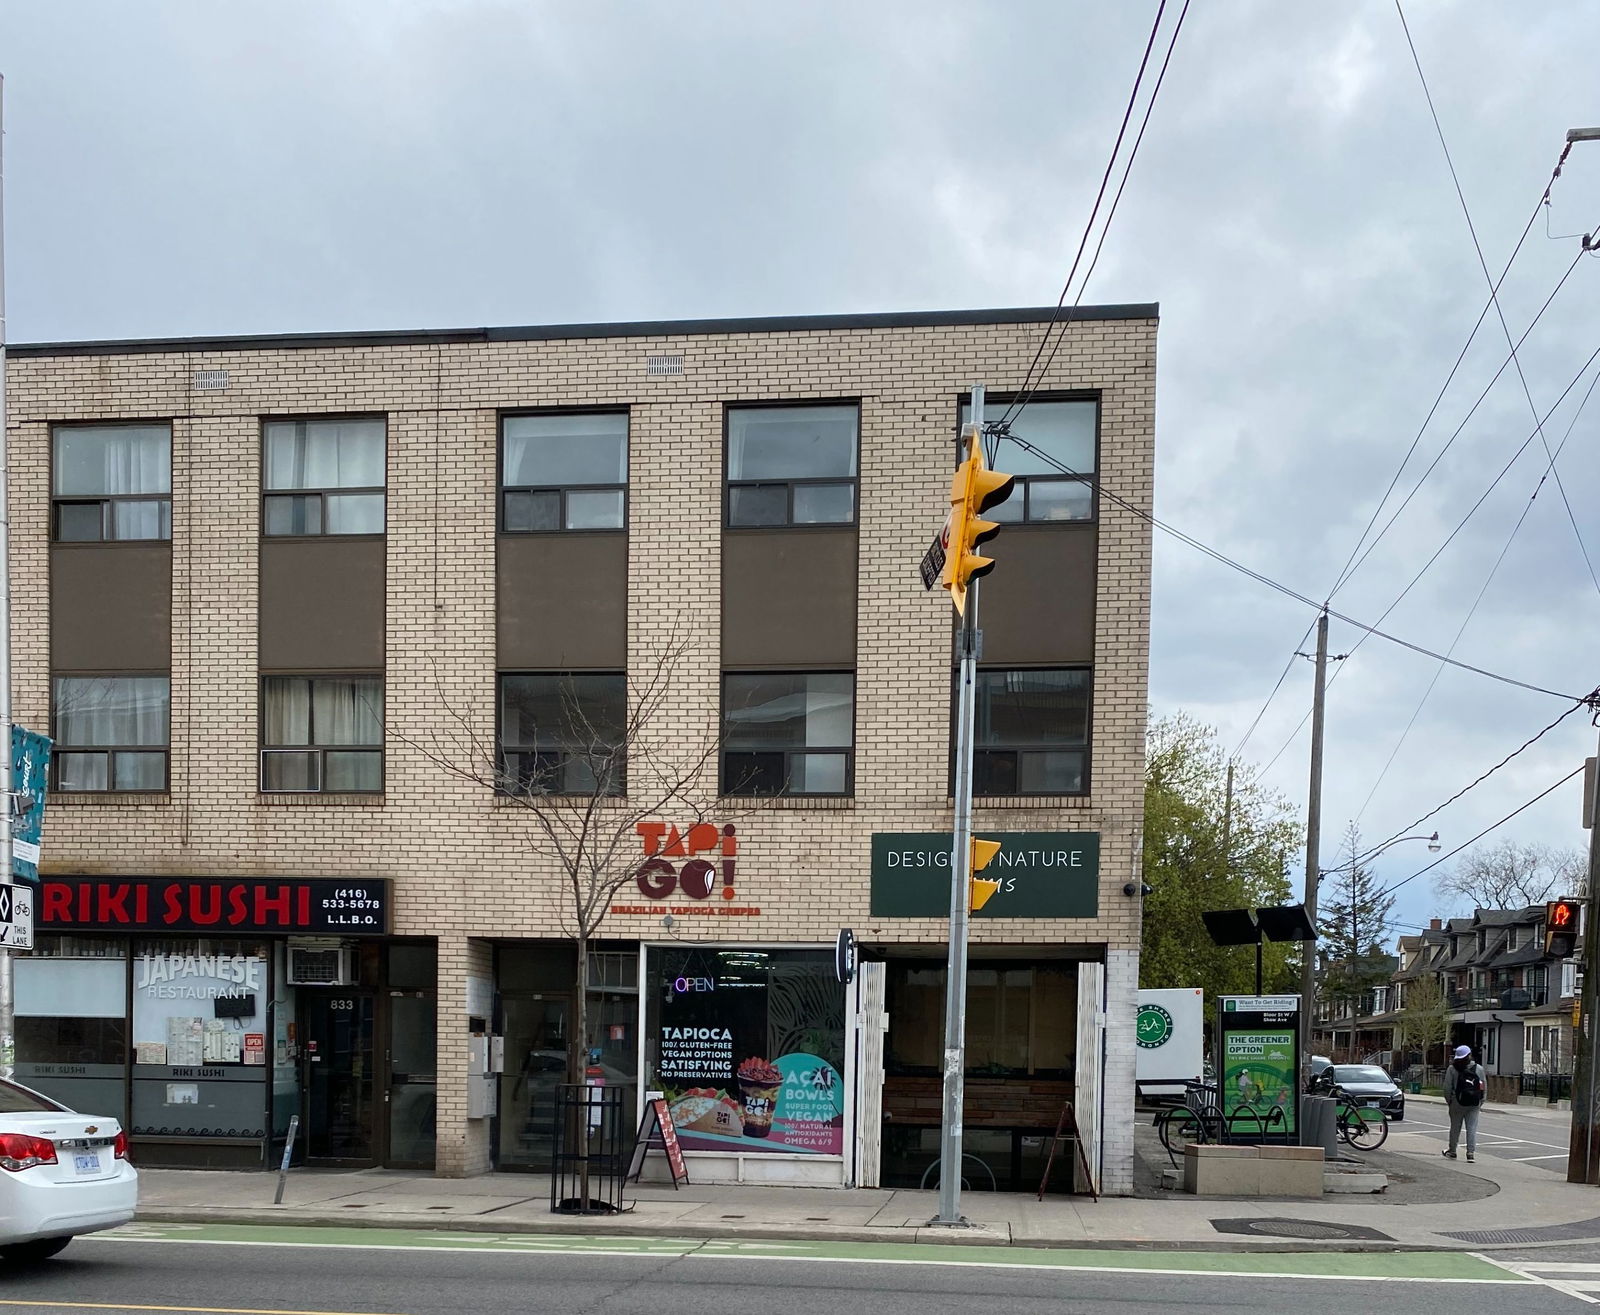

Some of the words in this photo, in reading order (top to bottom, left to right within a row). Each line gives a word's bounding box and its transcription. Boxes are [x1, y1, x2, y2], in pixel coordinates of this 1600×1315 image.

[887, 851, 954, 867] DESIG
[999, 850, 1083, 867] NATURE
[636, 858, 736, 900] GO!
[334, 888, 368, 900] (416)
[42, 882, 149, 924] RIKI
[162, 883, 311, 926] SUSHI
[322, 899, 380, 909] 533-5678
[669, 907, 716, 915] TAPIOCA
[327, 915, 378, 924] L.L.B.O.
[13, 925, 27, 935] THIS
[12, 936, 28, 946] LANE
[138, 955, 260, 991] JAPANESE
[675, 977, 715, 993] OPEN
[148, 985, 250, 999] RESTAURANT
[330, 1000, 354, 1009] 833
[661, 1026, 733, 1040] TAPIOCA
[247, 1038, 263, 1046] OPEN
[679, 1041, 733, 1049] GLUTEN-FREE
[1229, 1036, 1247, 1044] THE
[1248, 1036, 1290, 1044] GREENER
[661, 1050, 693, 1058] VEGAN
[34, 1065, 55, 1074] RIKI
[58, 1066, 86, 1074] SUSHI
[661, 1059, 732, 1070] SATISFYING
[172, 1068, 193, 1077] RIKI
[197, 1068, 225, 1077] SUSHI
[785, 1089, 835, 1101] BOWLS
[786, 1111, 833, 1122] VEGAN
[784, 1137, 816, 1145] OMEGA
[818, 1138, 833, 1146] 6/9
